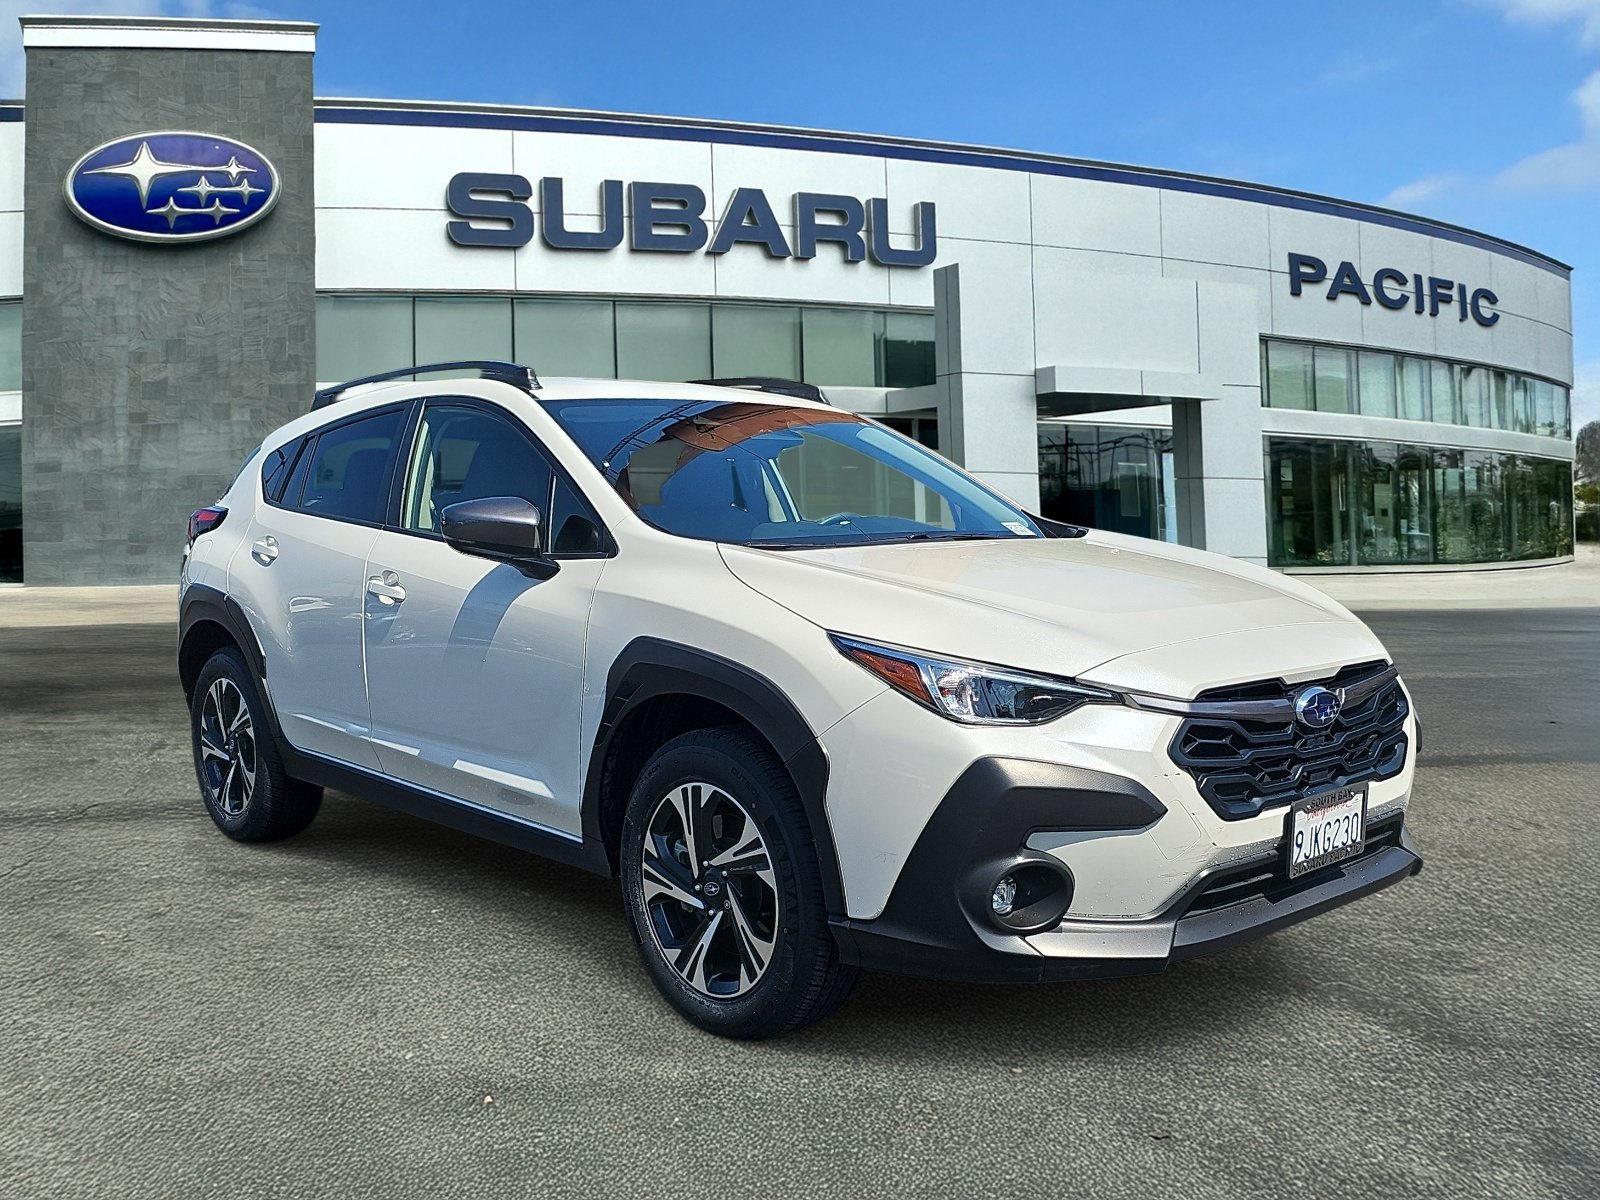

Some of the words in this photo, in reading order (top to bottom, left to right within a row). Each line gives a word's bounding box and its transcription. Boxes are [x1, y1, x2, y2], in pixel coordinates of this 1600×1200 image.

[446, 172, 937, 267] SUBARU
[1288, 252, 1500, 327] PACIFIC
[1311, 793, 1336, 807] SOUTH
[1294, 812, 1359, 864] 9JKG230
